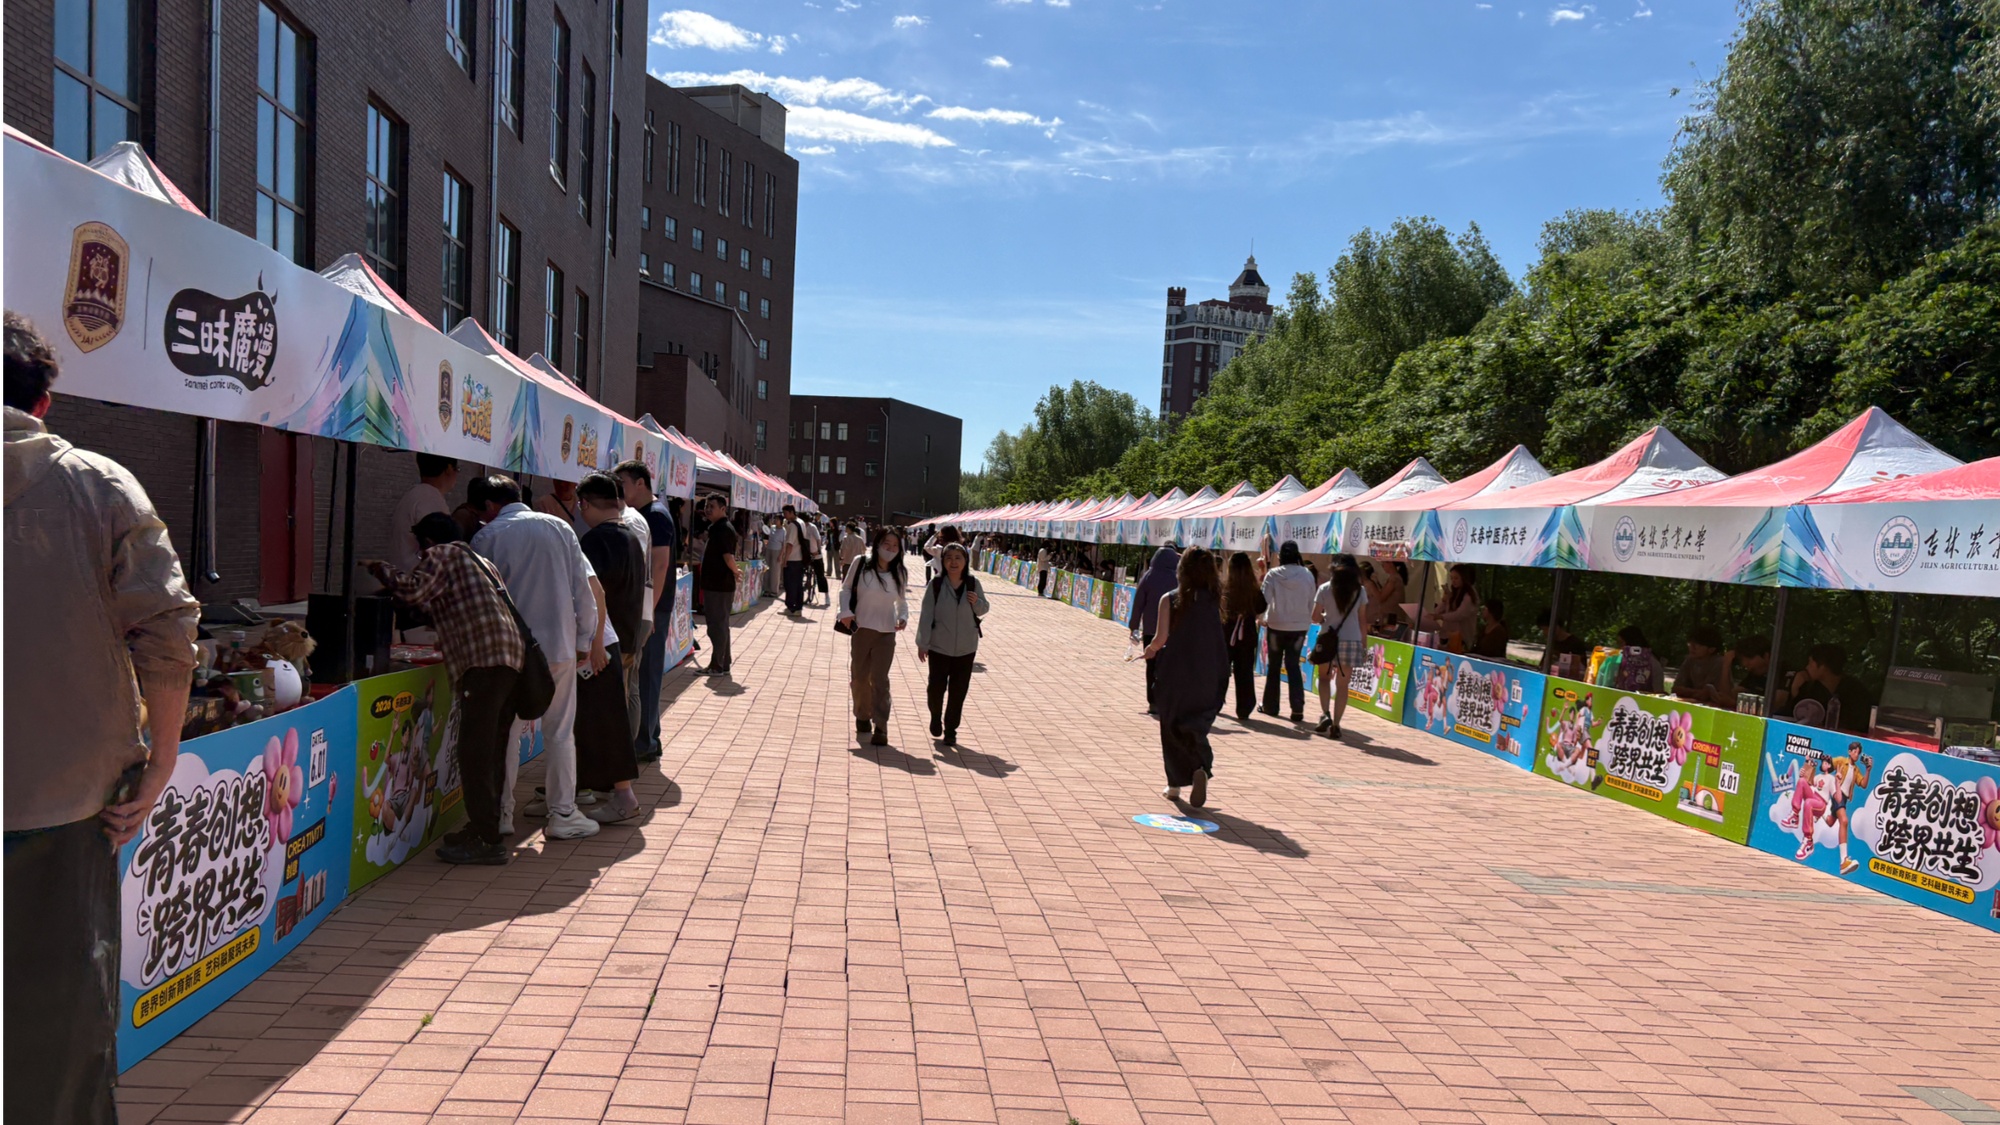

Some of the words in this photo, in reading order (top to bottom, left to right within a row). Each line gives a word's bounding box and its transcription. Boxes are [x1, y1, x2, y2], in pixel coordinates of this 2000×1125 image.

[1364, 525, 1405, 540] 长春中医药大学
[1470, 526, 1527, 545] 长春中医药大学
[1940, 563, 1999, 571] AGRICULTURAL
[312, 732, 323, 747] DATE
[1609, 708, 1669, 752] 青春创想
[1788, 735, 1810, 747] YOUTH
[1693, 741, 1719, 756] ORIGINAL
[1786, 744, 1822, 759] CREATIVITY
[311, 748, 326, 783] 6.01
[1610, 743, 1667, 784] 跨界共生
[1722, 763, 1733, 771] DATE
[1720, 773, 1737, 791] 6.01
[1878, 768, 1979, 834] 青春创想
[138, 776, 265, 897] 青春创想
[287, 822, 325, 859] CREATIVITY
[1878, 818, 1980, 880] 跨界共生
[145, 847, 265, 978] 跨界共生
[141, 966, 202, 1019] 跨界创新育新质
